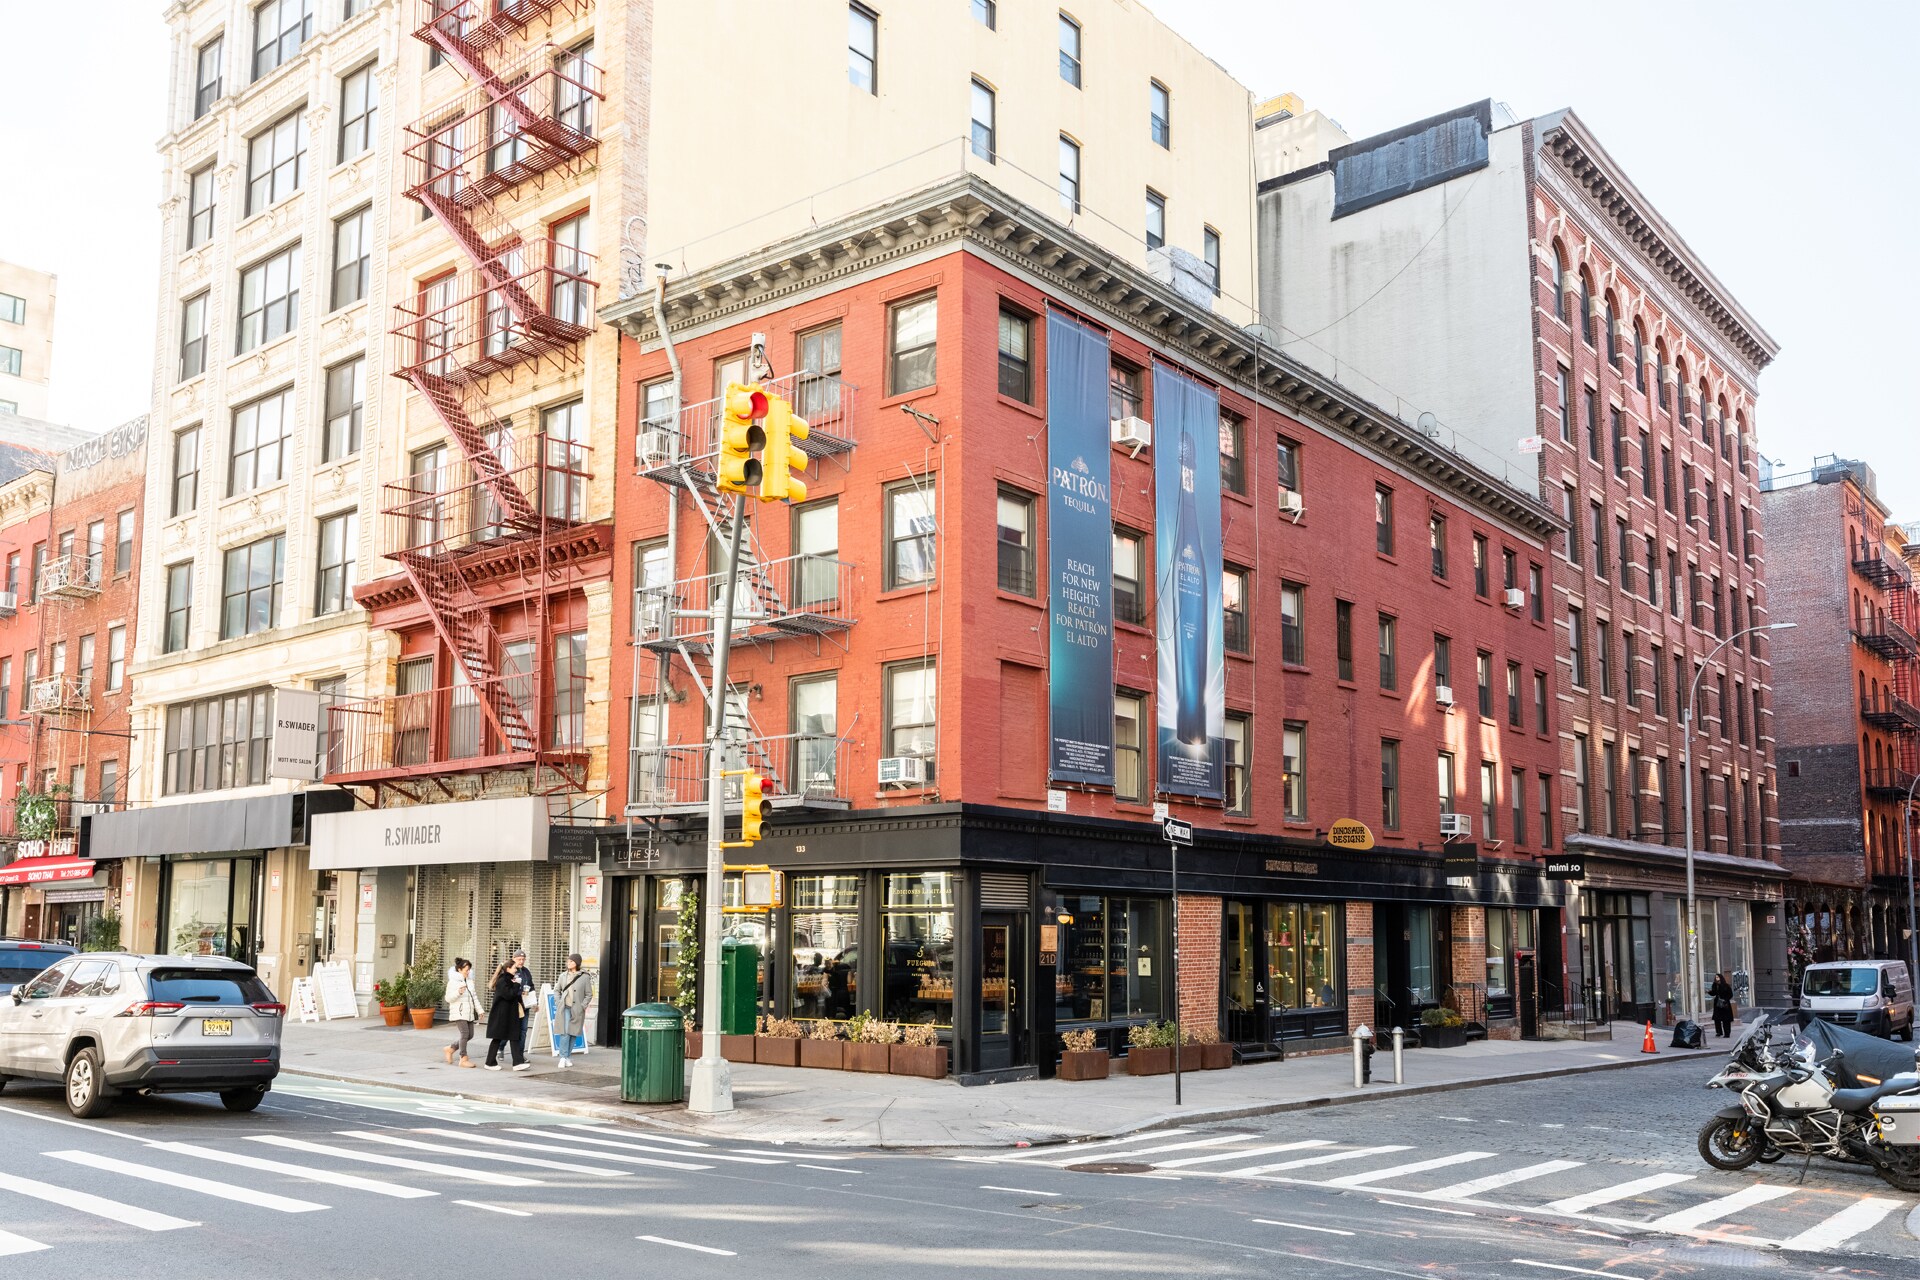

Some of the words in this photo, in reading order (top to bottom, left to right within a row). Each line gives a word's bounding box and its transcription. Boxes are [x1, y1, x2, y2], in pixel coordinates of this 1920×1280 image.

[1063, 494, 1096, 515] TEQUILA
[1067, 558, 1095, 577] REACH
[1062, 571, 1079, 587] FOR
[1081, 578, 1100, 592] NEW
[1062, 586, 1101, 607] HEIGHTS,
[1068, 601, 1095, 619] REACH
[1056, 613, 1073, 628] FOR
[1075, 618, 1107, 636] PATRÓN
[1066, 630, 1075, 643] EL
[1077, 633, 1098, 648] ALTO
[278, 719, 316, 732] R.SWIADER
[384, 824, 441, 847] R.SWIADER
[1167, 824, 1177, 835] ONE
[1179, 826, 1189, 837] WAY
[1332, 826, 1365, 835] DINOSAUR
[1332, 835, 1366, 843] DESIGNS
[17, 840, 44, 859] SOHO
[48, 837, 72, 856] THAI
[643, 848, 660, 859] SPA
[795, 845, 806, 853] 133
[1548, 862, 1569, 872] mimi
[1570, 863, 1581, 872] so
[27, 871, 42, 881] SOHO
[42, 870, 55, 880] THAI
[1040, 953, 1056, 964] 21D
